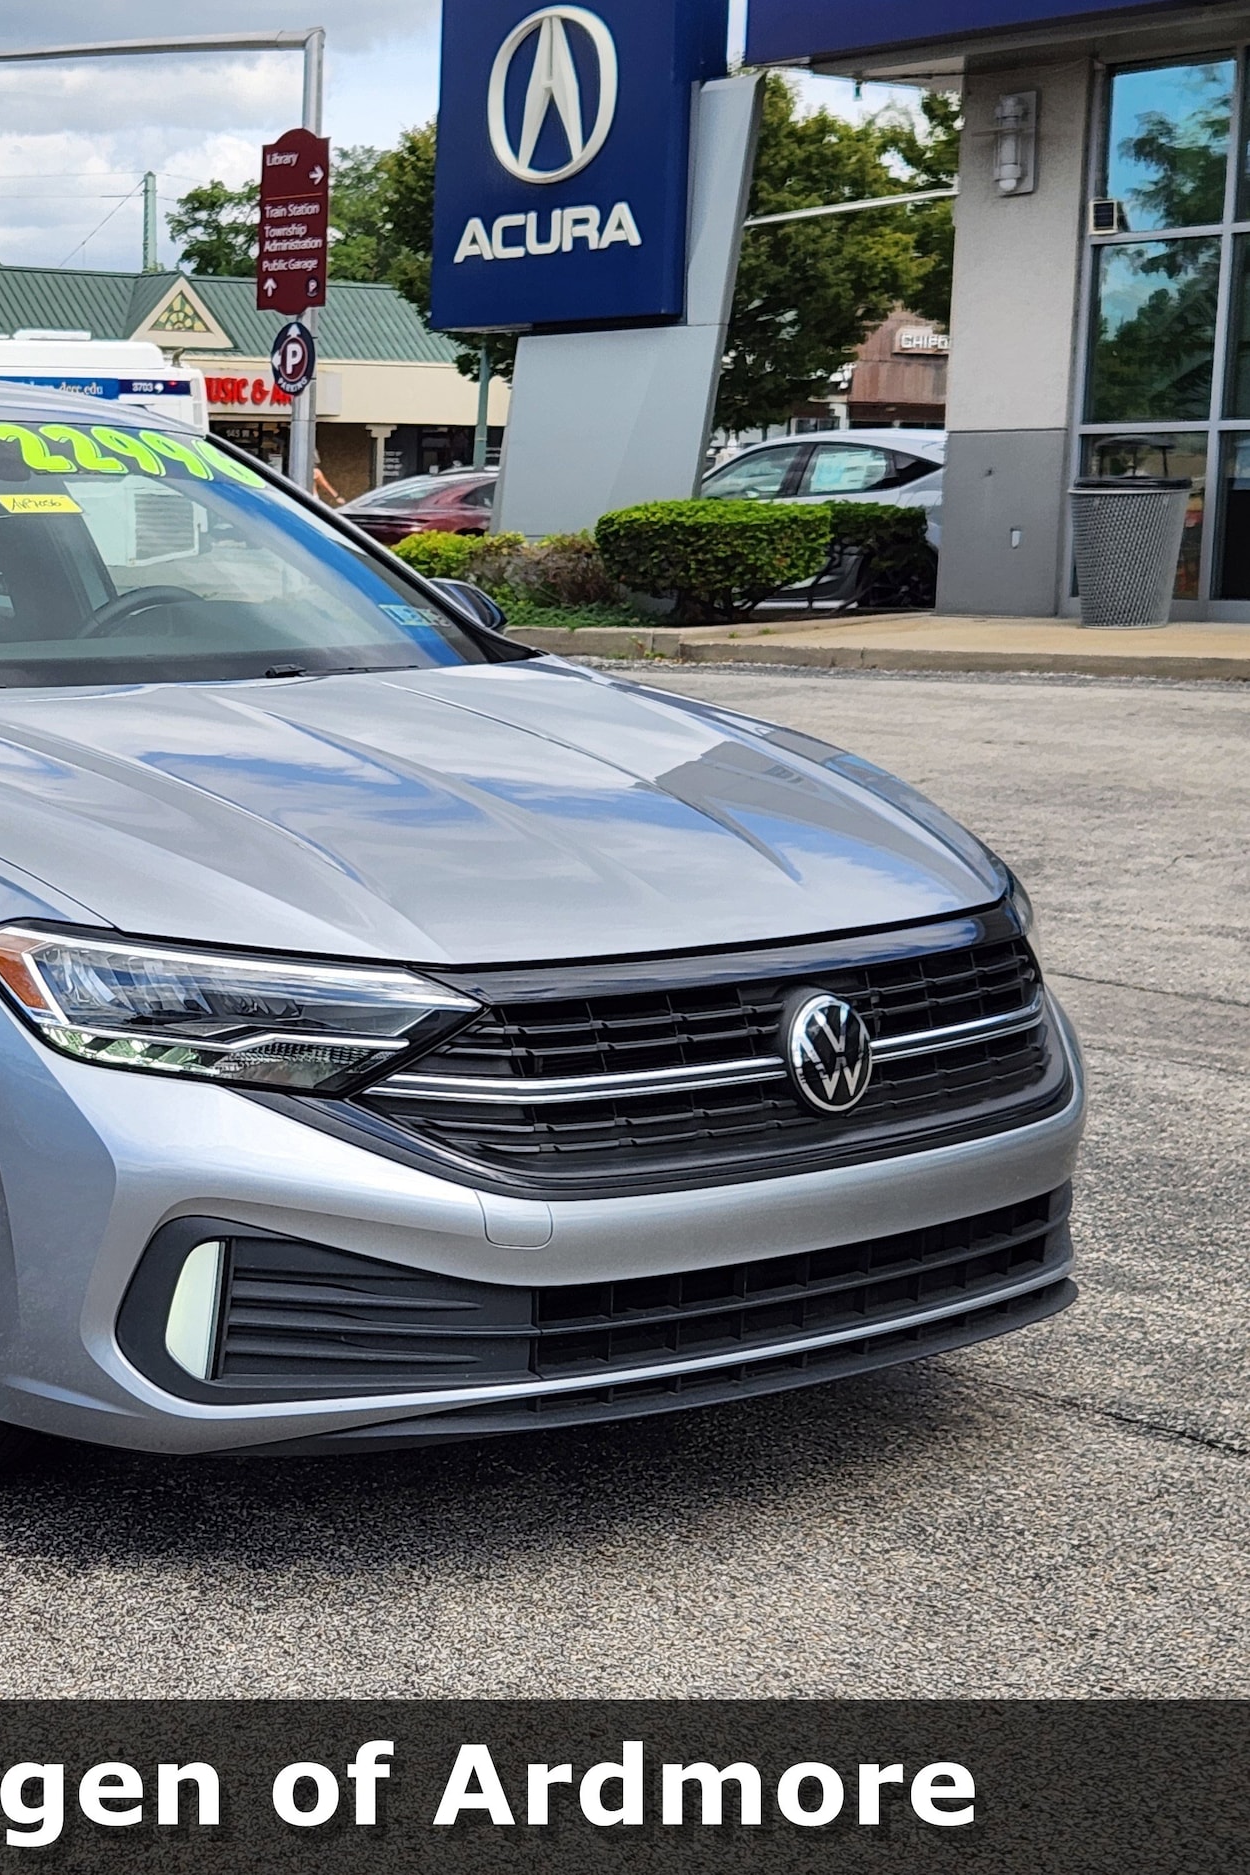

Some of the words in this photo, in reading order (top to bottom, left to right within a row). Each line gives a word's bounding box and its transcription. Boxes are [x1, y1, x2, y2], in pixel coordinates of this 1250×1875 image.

[266, 152, 299, 167] Library
[264, 204, 287, 218] Train
[288, 202, 320, 217] Station
[264, 223, 307, 238] Township
[453, 201, 642, 264] ACURA
[263, 237, 323, 252] Administration
[262, 258, 288, 272] Public
[288, 257, 318, 271] Garage
[286, 343, 303, 374] P
[205, 377, 248, 404] USIC
[251, 379, 270, 405] &
[277, 376, 308, 392] PARKING
